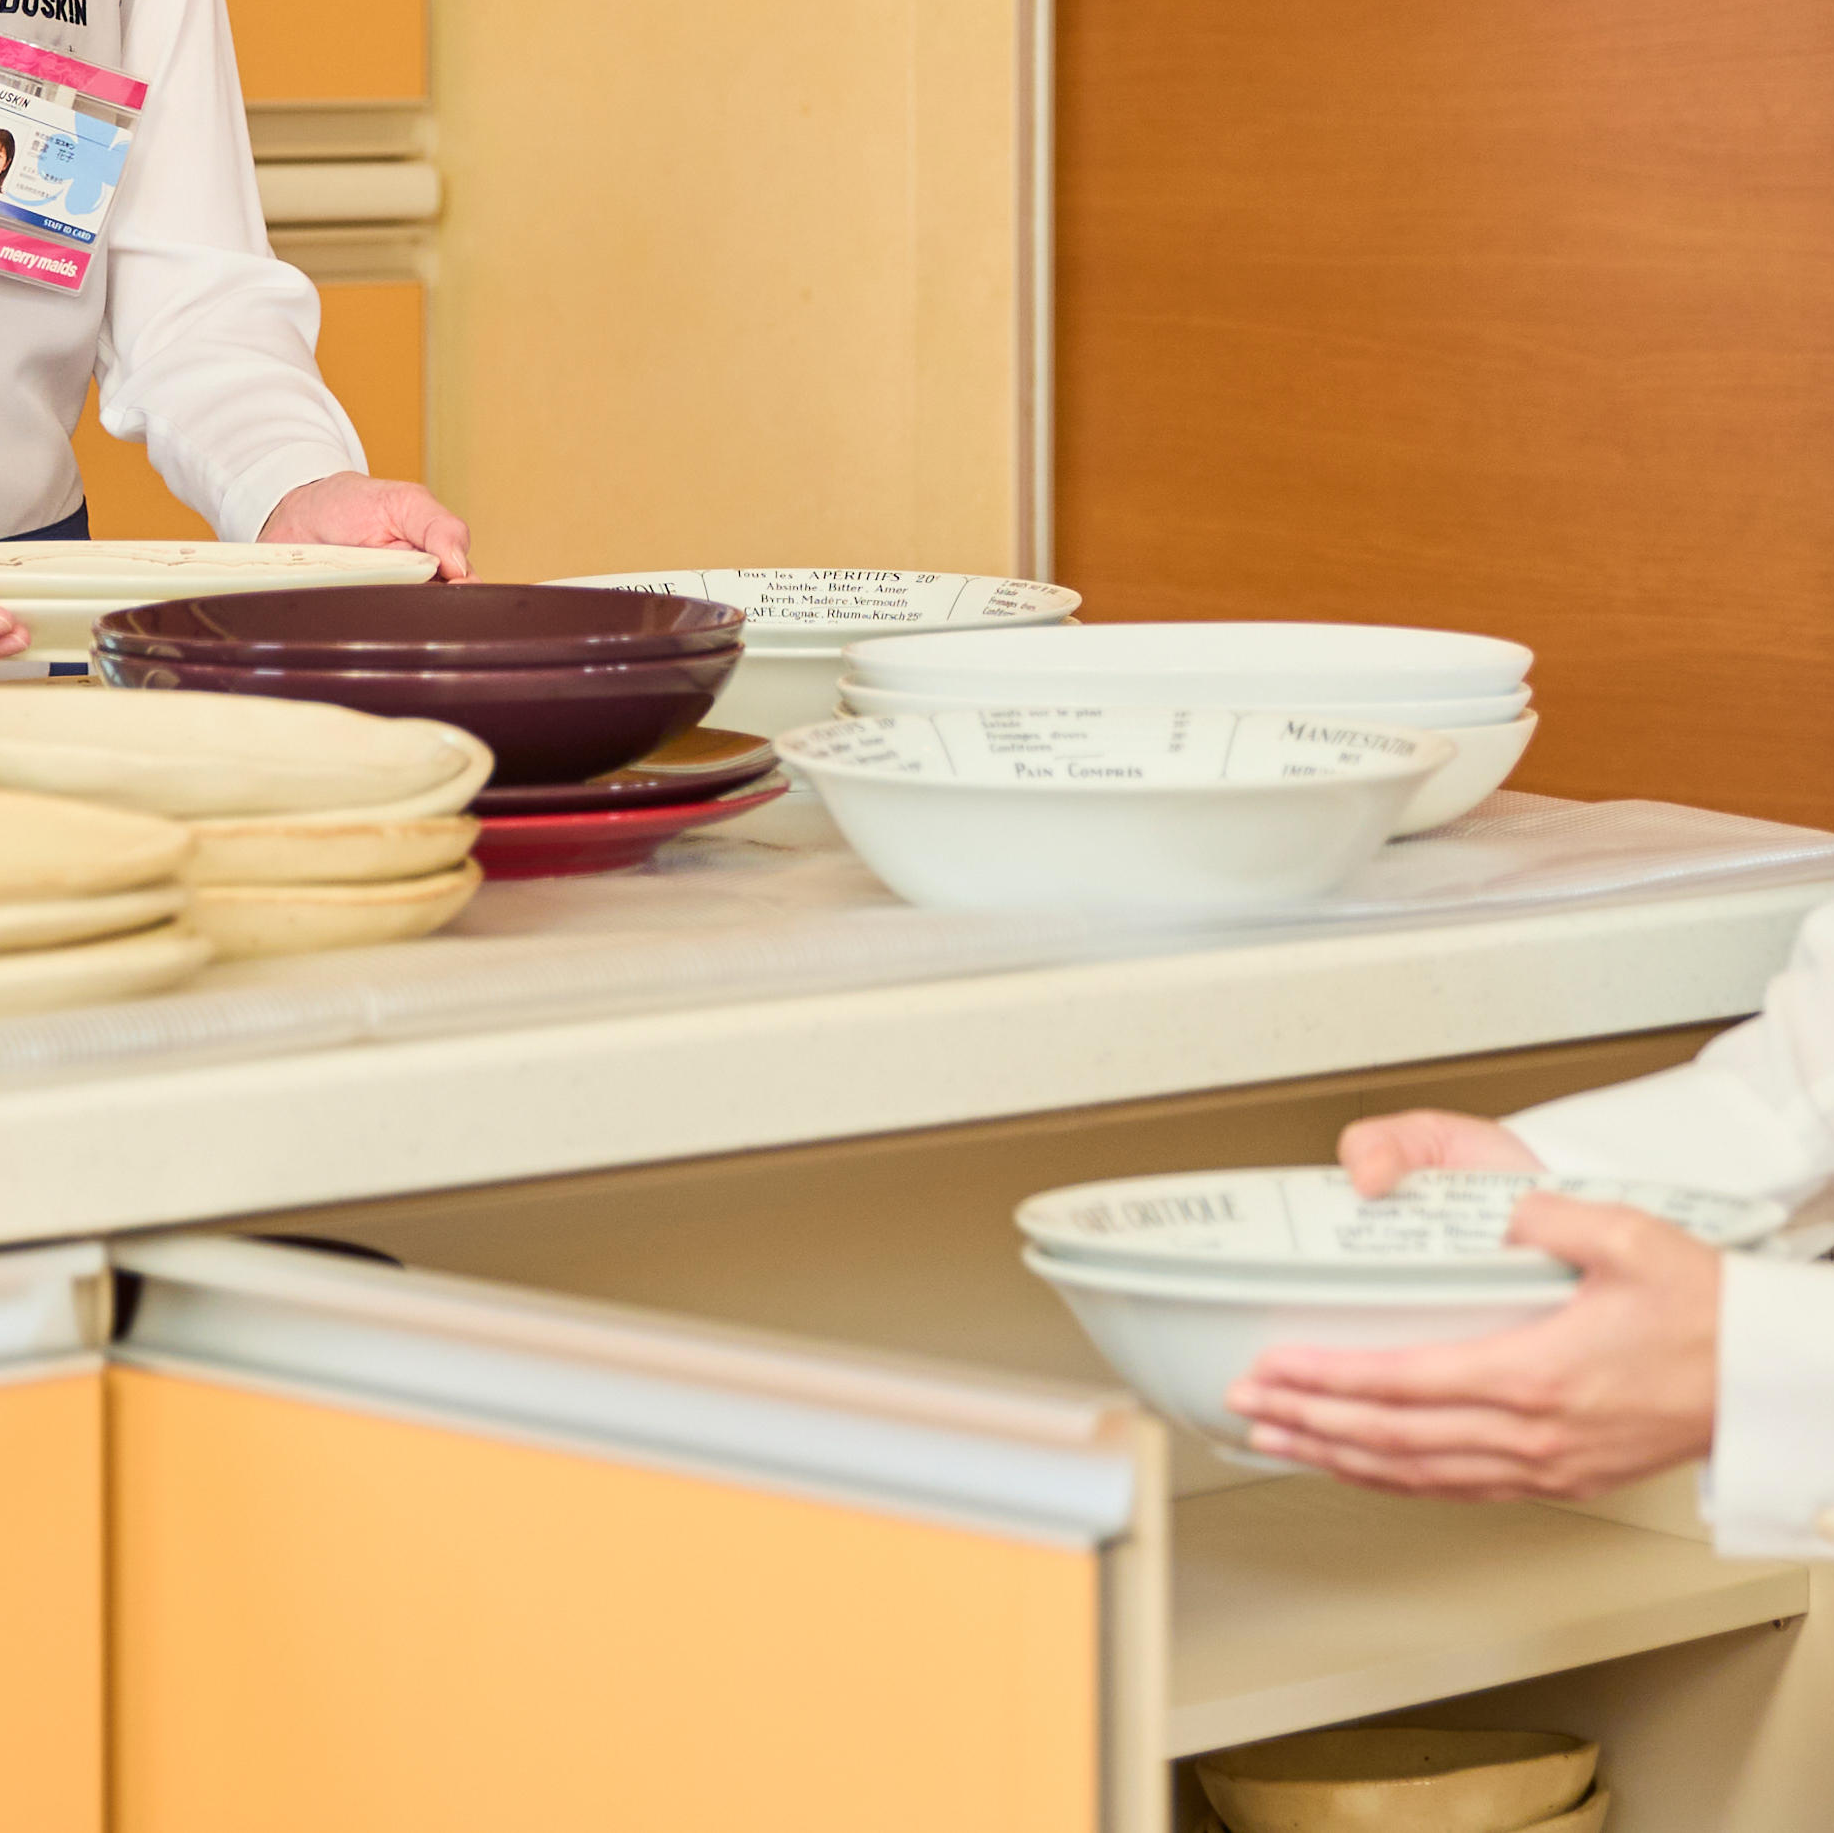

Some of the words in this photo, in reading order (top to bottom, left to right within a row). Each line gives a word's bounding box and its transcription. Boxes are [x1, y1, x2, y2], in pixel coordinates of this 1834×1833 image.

[43, 219, 63, 232] STAFF
[72, 228, 92, 241] CARD
[0, 246, 39, 269] merry
[36, 256, 78, 278] maids
[875, 584, 909, 594] Amer
